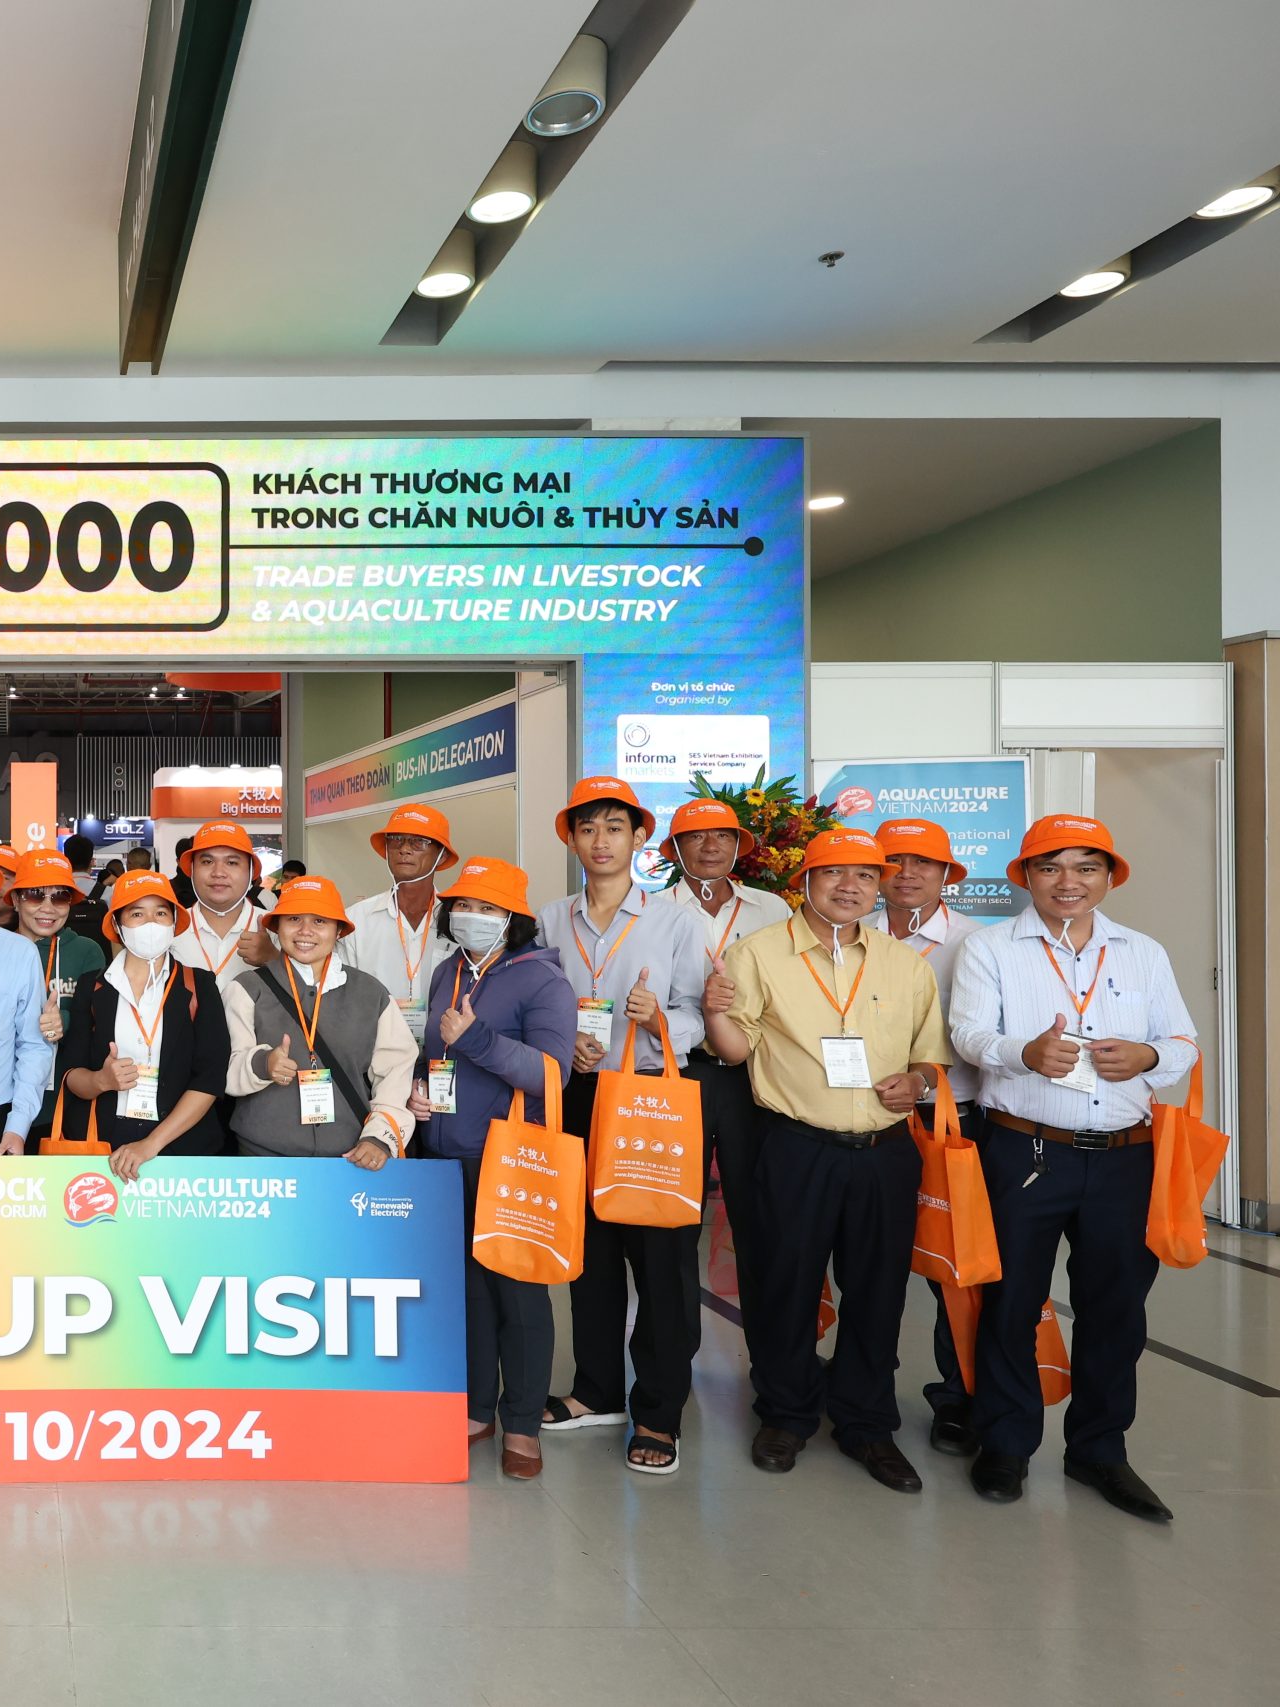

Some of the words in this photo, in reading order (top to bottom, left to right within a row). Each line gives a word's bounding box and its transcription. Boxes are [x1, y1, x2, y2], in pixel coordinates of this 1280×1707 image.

[252, 468, 363, 495] KHÁCH
[370, 468, 505, 495] THƯƠNG
[512, 470, 571, 500] MẠI
[252, 507, 360, 530] TRONG
[368, 500, 459, 529] CHĂN
[467, 500, 545, 529] NUÔI
[553, 506, 575, 530] &
[583, 498, 666, 529] THỦY
[675, 498, 739, 529] SẢN
[253, 564, 355, 588] TRADE
[362, 564, 486, 588] BUYERS
[491, 564, 526, 588] IN
[532, 564, 705, 588] LIVESTOCK
[252, 600, 273, 623] &
[277, 599, 513, 625] AQUACULTURE
[519, 599, 679, 623] INDUSTRY
[655, 695, 716, 706] Organised
[717, 695, 733, 706] by
[396, 752, 428, 783] BUS-IN
[429, 729, 506, 773] DELEGATION
[625, 752, 677, 764] informa
[625, 764, 675, 777] markets
[717, 761, 747, 769] Company
[326, 779, 346, 803] QUAN
[346, 773, 366, 795] THEO
[366, 763, 391, 790] ĐOÀN
[238, 786, 280, 801] 大牧人
[877, 786, 1009, 803] AQUACULTURE
[221, 802, 238, 817] Big
[240, 803, 282, 814] Herdsm
[105, 824, 144, 835] STOLZ
[948, 829, 1010, 840] national
[963, 884, 1011, 897] 2024
[988, 897, 1012, 905] (SECC)
[633, 1095, 671, 1110] 大牧人
[617, 1106, 632, 1117] Big
[634, 1107, 683, 1122] Herdsman
[517, 1145, 548, 1164] 大牧人
[501, 1155, 516, 1168] Big
[517, 1158, 559, 1177] Herdsman
[122, 1177, 297, 1199] AQUACULTURE
[370, 1202, 414, 1210] Renewable
[370, 1209, 409, 1219] Electricity
[139, 1275, 421, 1358] VISIT
